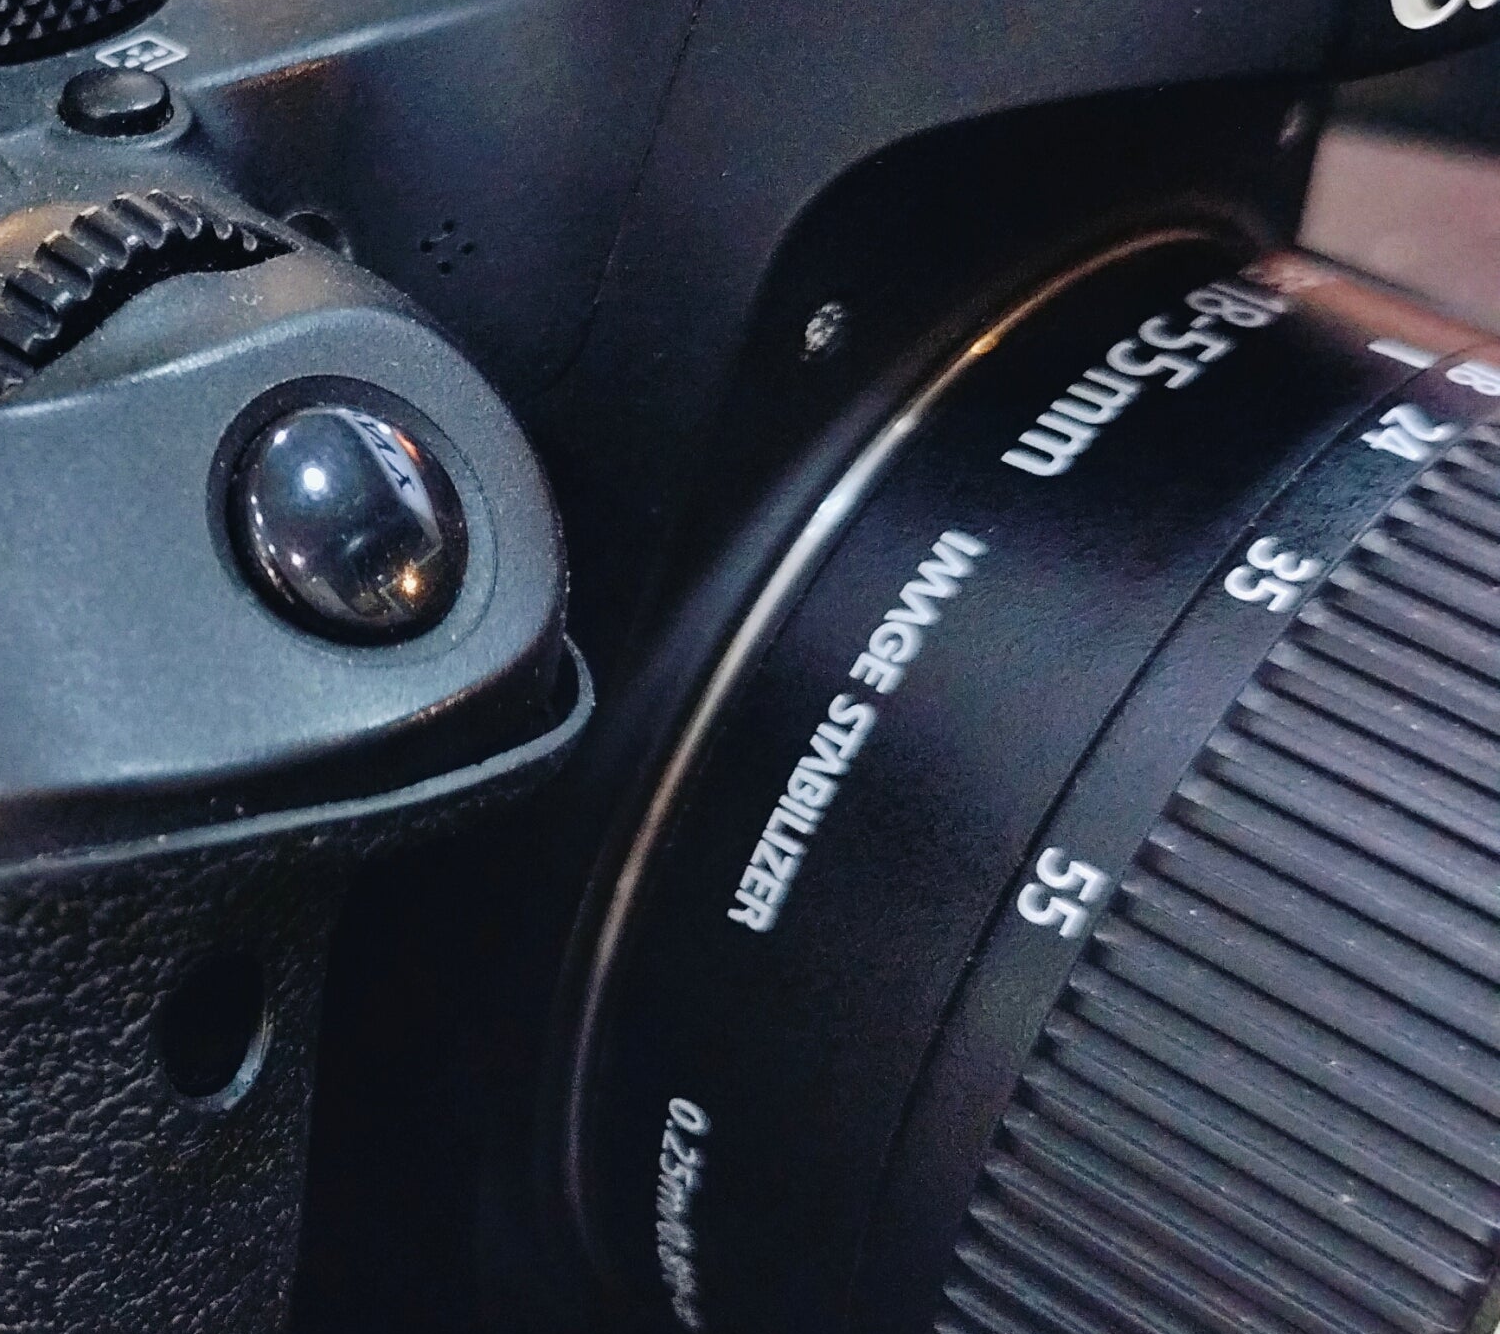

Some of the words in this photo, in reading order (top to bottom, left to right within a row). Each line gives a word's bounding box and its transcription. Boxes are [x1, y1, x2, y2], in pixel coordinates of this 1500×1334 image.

[1000, 280, 1293, 477] 18-55mm
[1360, 402, 1460, 462] 24
[848, 529, 989, 695] IMAGE
[1224, 535, 1322, 613] 35
[727, 693, 878, 933] STABILIZER
[1016, 846, 1111, 938] 55
